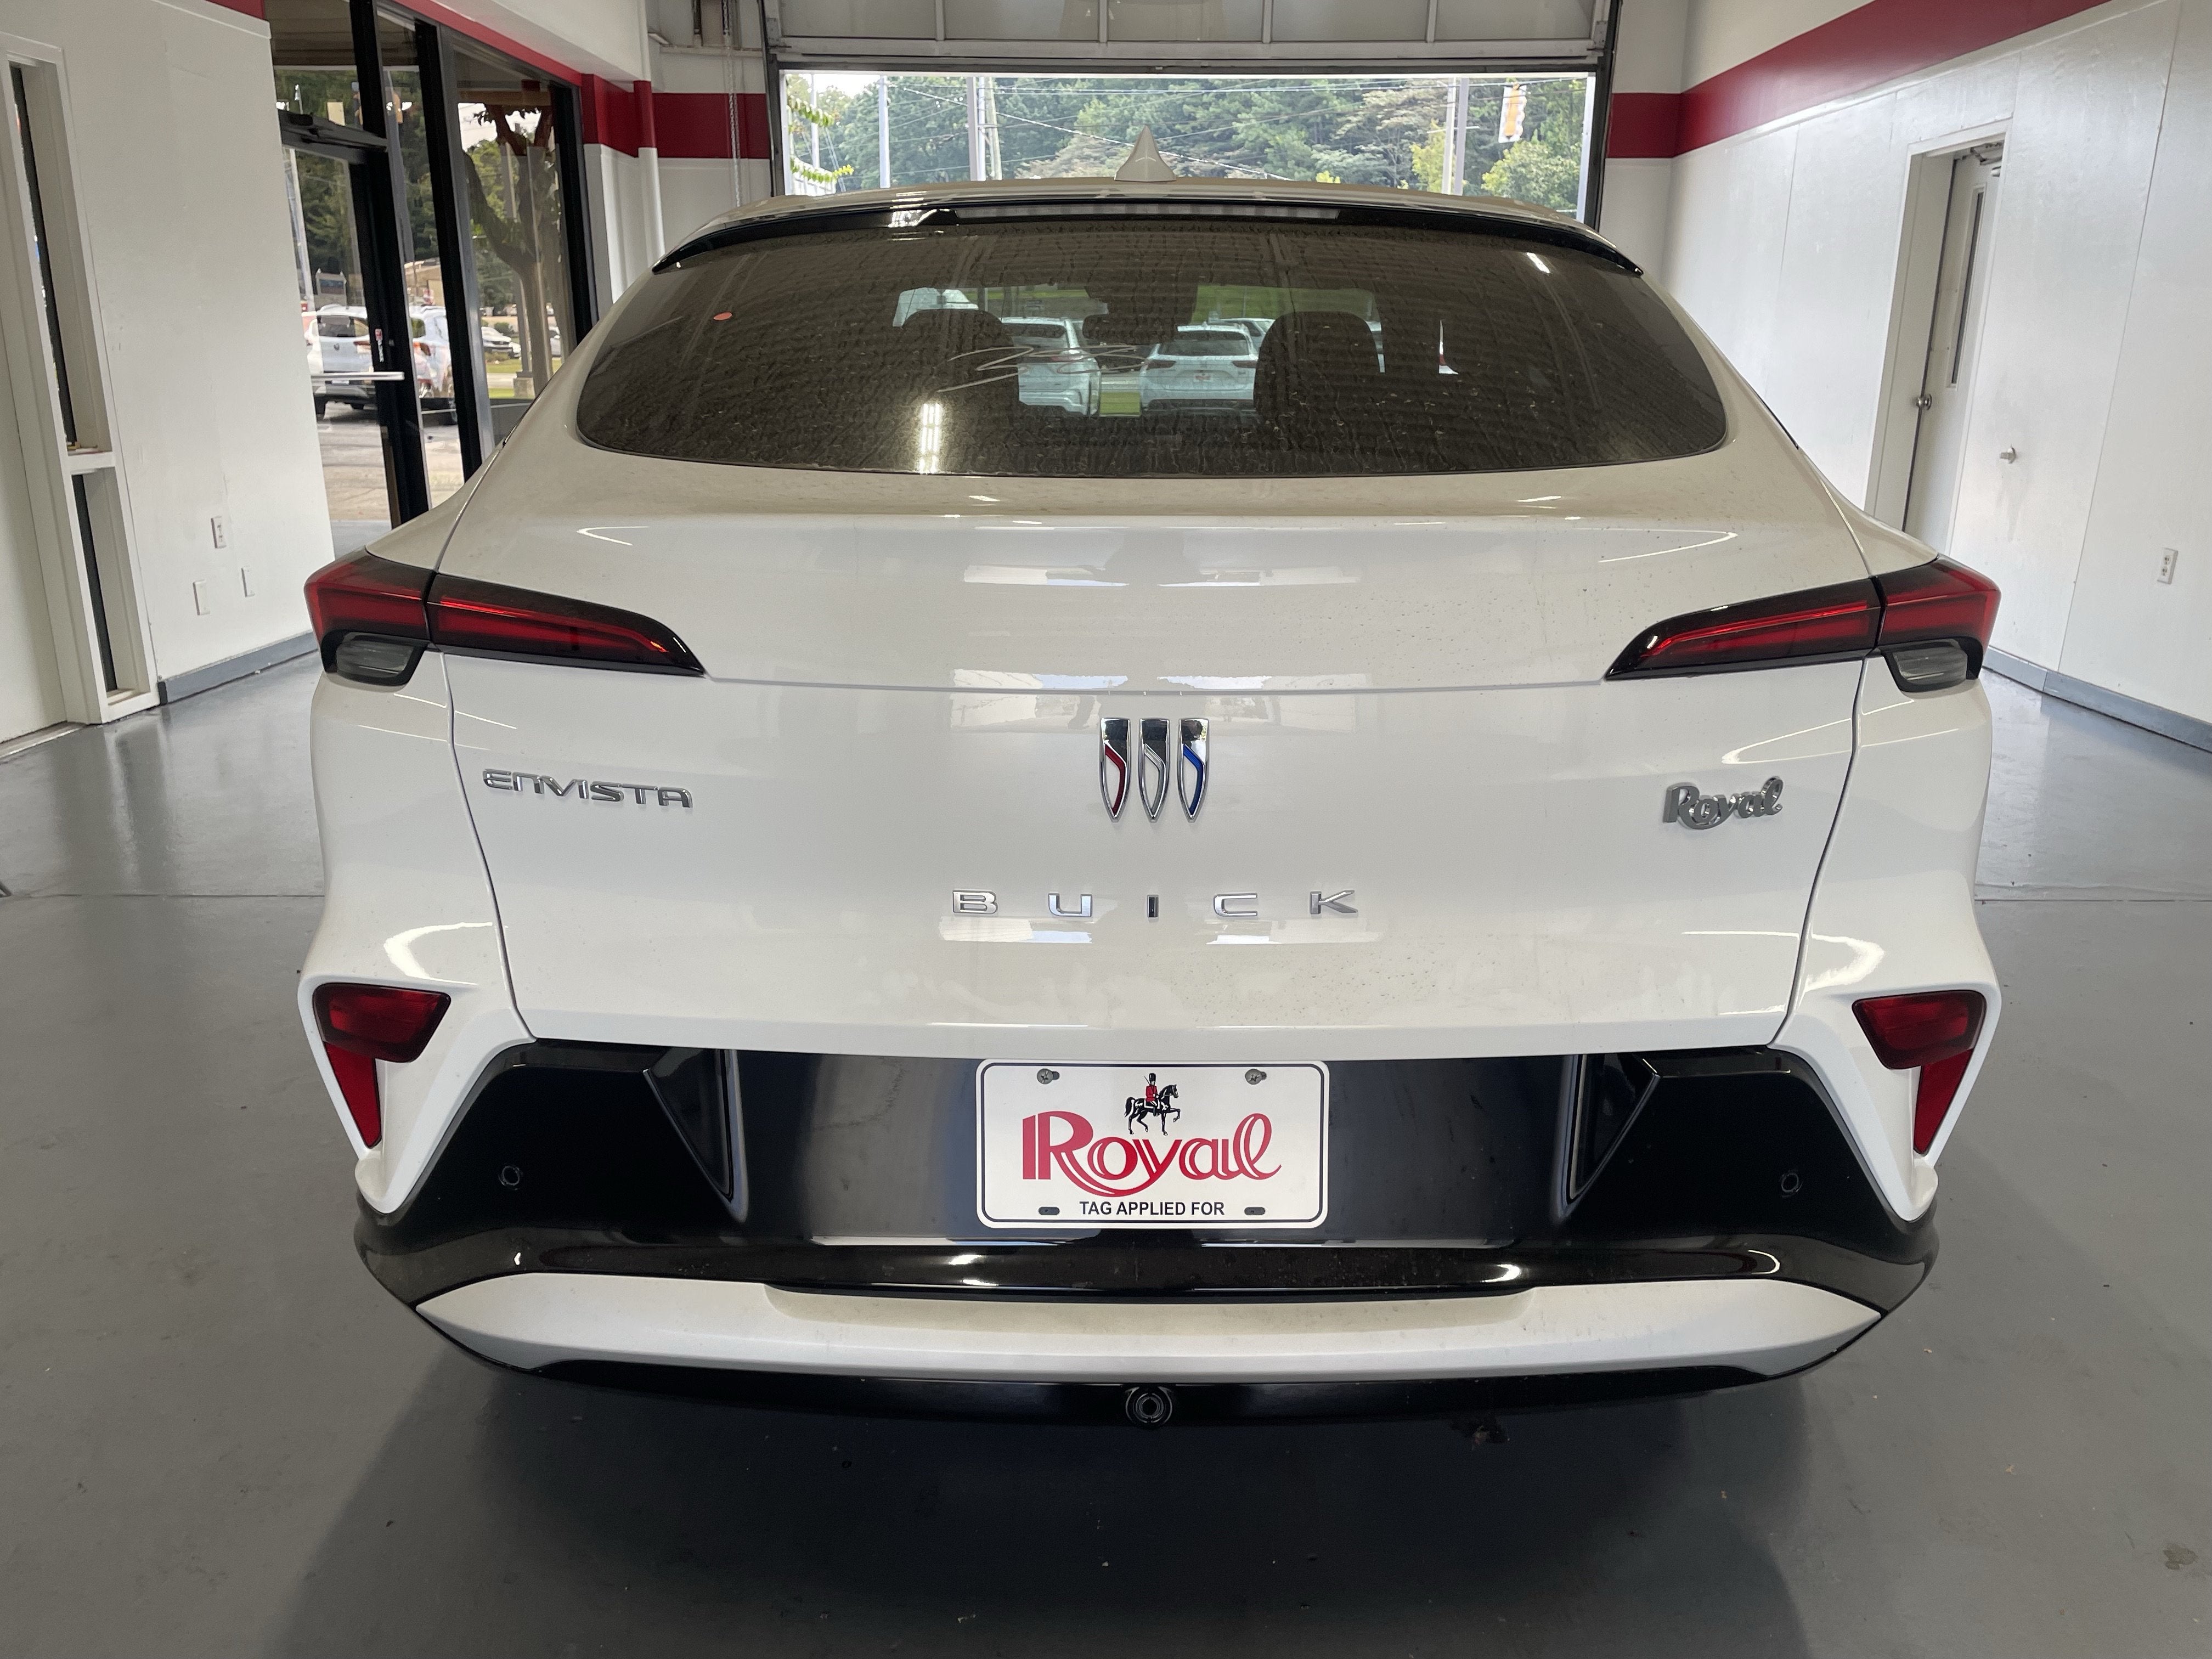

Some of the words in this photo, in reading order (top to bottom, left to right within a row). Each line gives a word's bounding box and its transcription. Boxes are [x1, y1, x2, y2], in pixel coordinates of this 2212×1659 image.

[483, 769, 693, 808] ENVISTA
[1662, 776, 1784, 830] Royal
[952, 890, 1358, 918] BUICK
[1023, 1111, 1282, 1197] Royal
[1079, 1201, 1112, 1216] TAG
[1116, 1201, 1186, 1216] APPLIED
[1191, 1201, 1224, 1216] FOR
